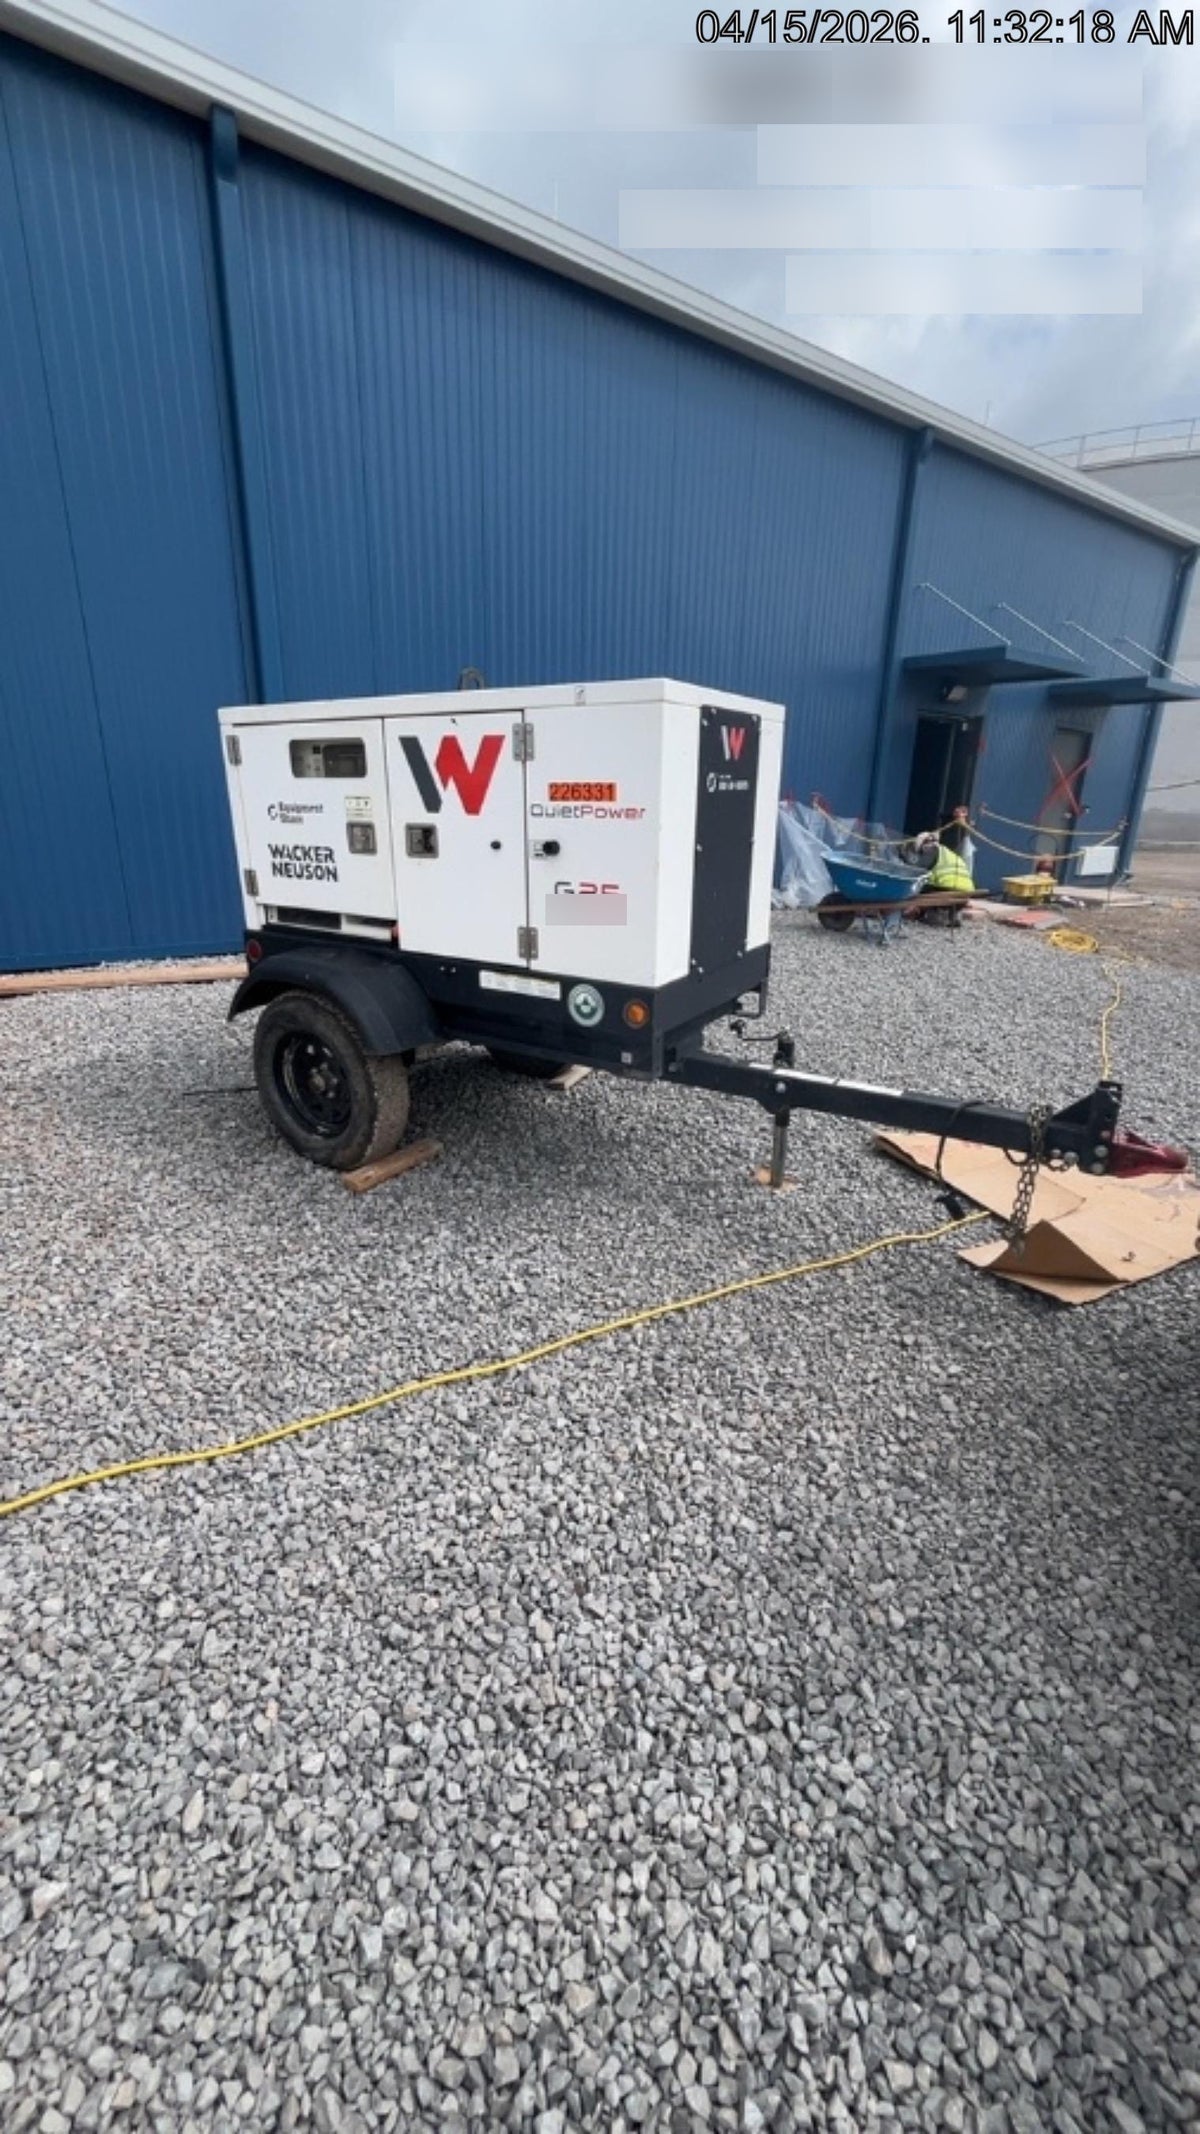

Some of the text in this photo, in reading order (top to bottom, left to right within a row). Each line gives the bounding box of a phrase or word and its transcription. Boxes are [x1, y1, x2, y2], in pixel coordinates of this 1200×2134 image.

[549, 782, 615, 801] 226331
[530, 803, 646, 820] QuietPower
[267, 843, 336, 864] WACKER
[271, 861, 338, 883] NEUSON
